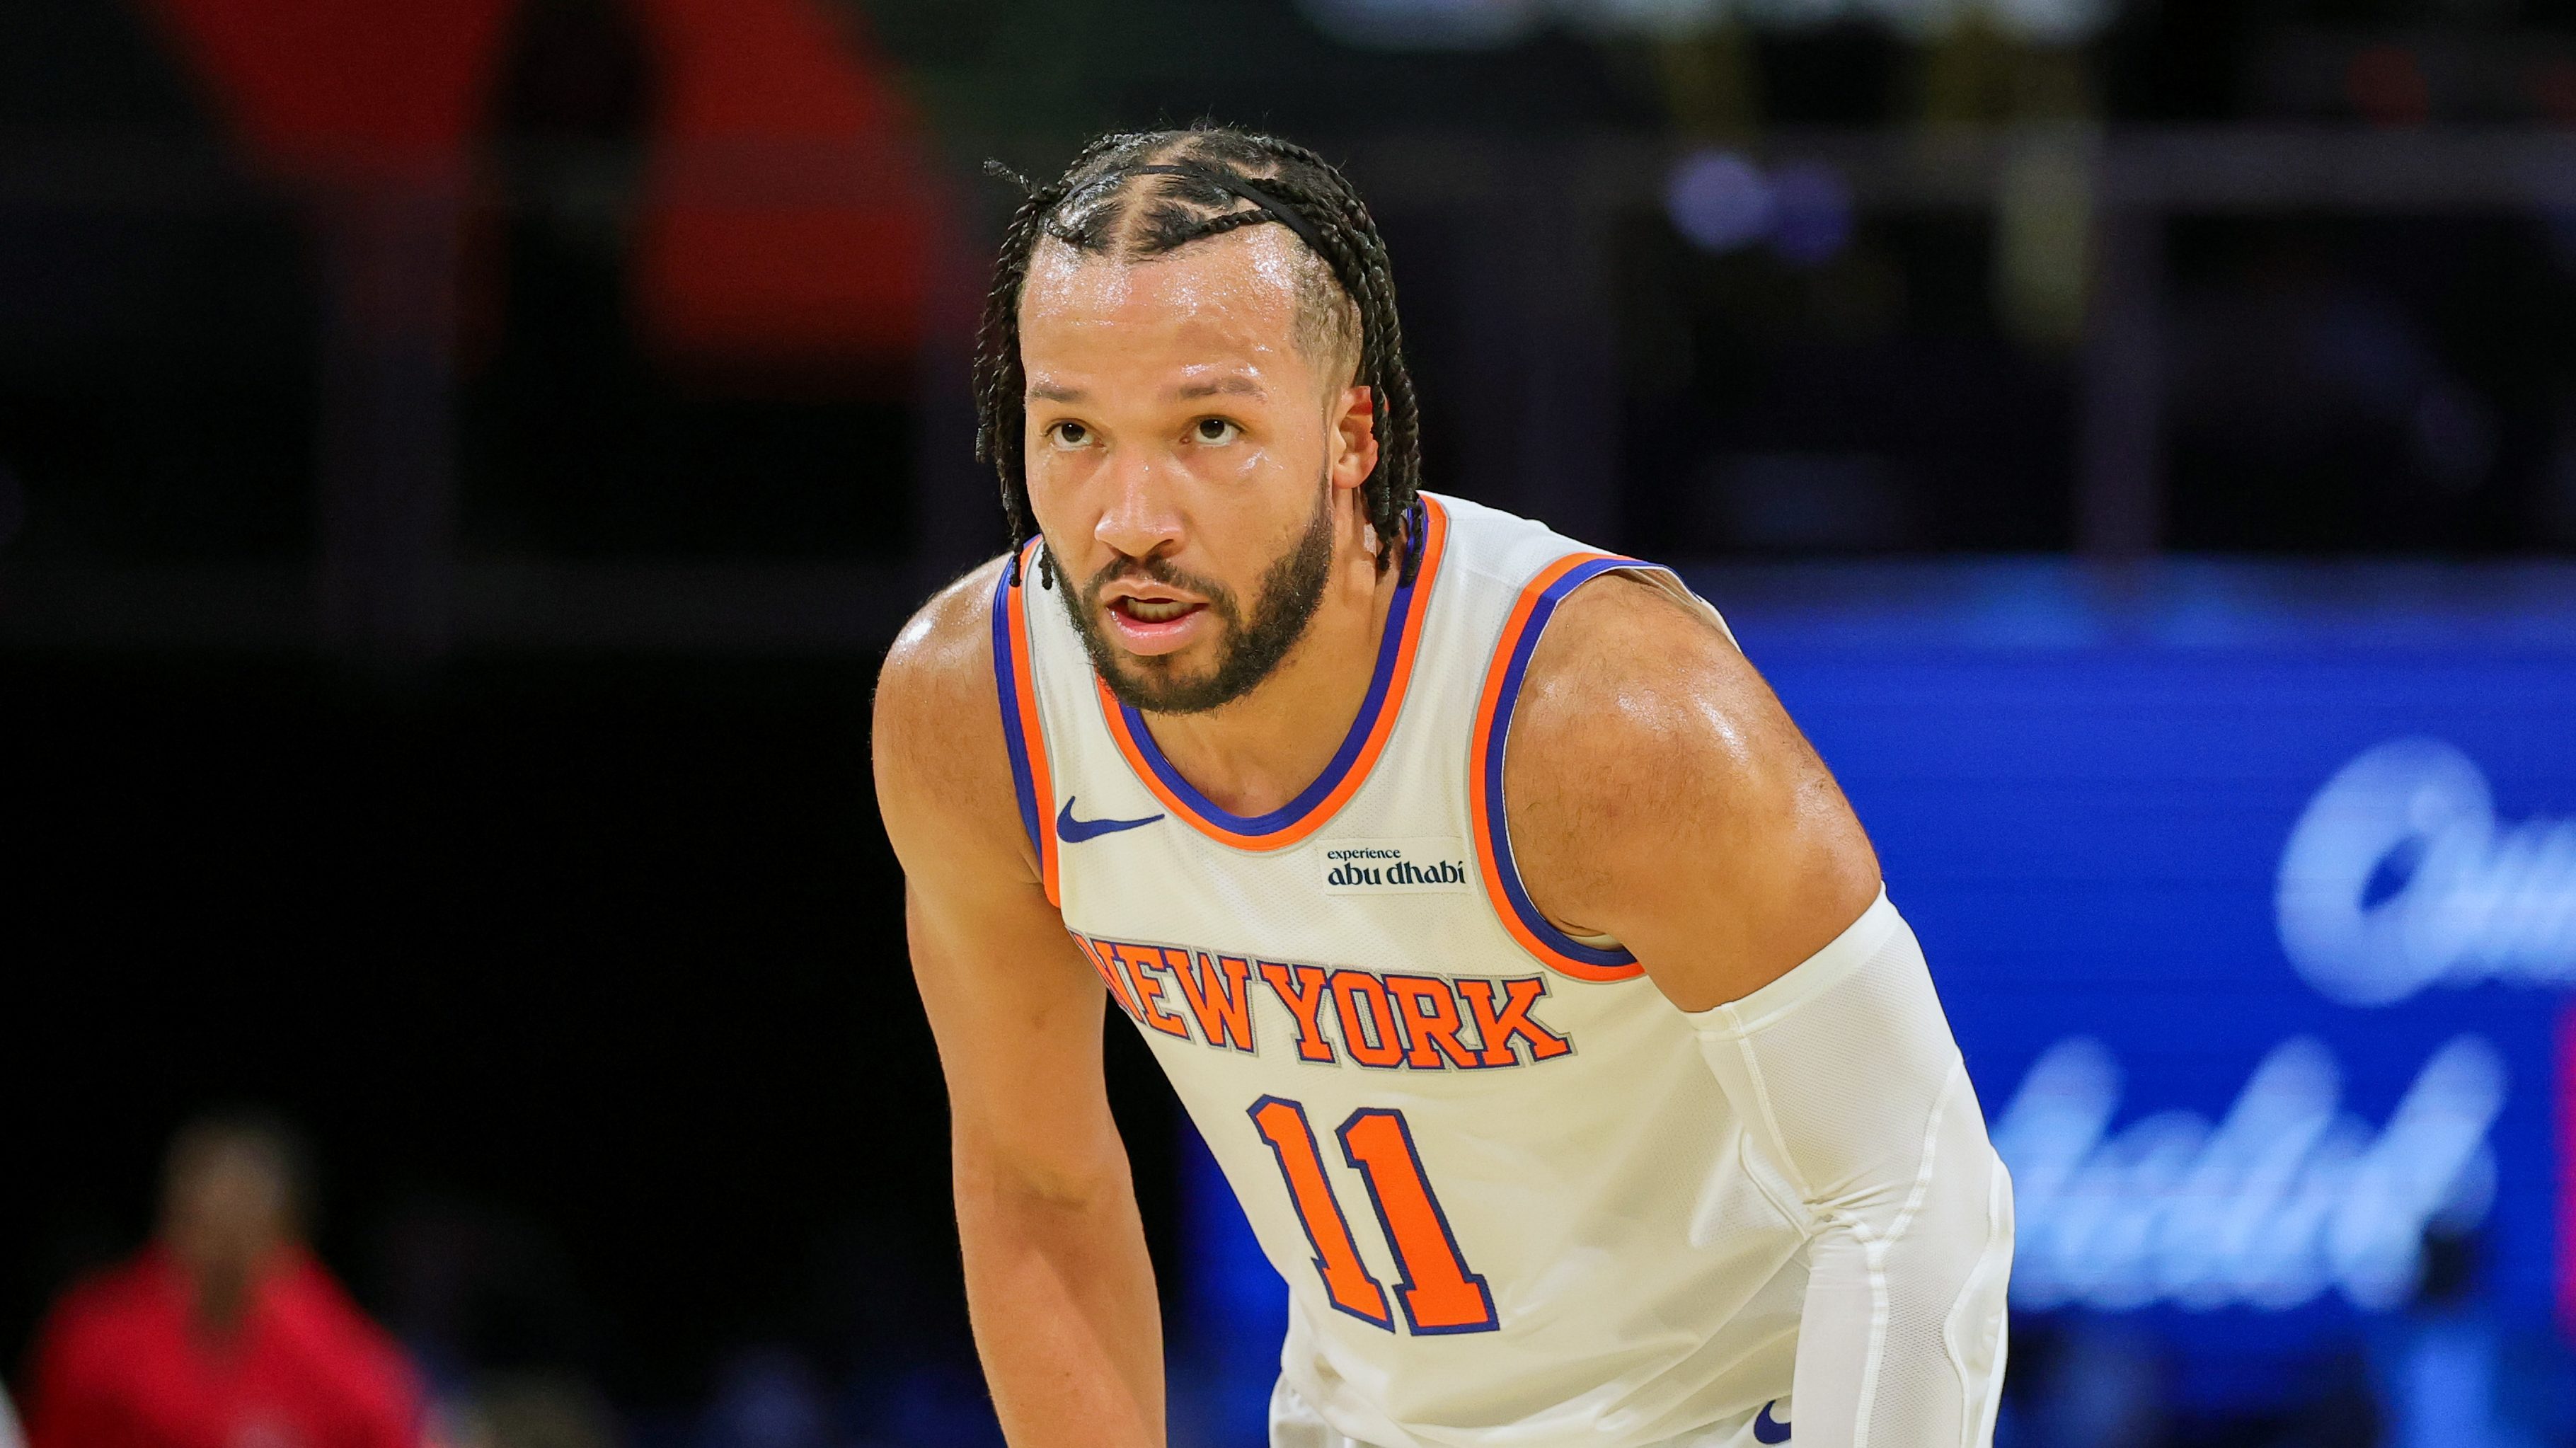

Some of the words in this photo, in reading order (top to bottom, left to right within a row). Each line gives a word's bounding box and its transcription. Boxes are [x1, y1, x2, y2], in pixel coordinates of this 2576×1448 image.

[1327, 847, 1401, 861] experience
[1328, 861, 1382, 885] abu
[1386, 860, 1466, 885] dhabi
[1256, 959, 1573, 1070] YORK
[1246, 1093, 1501, 1337] 11
